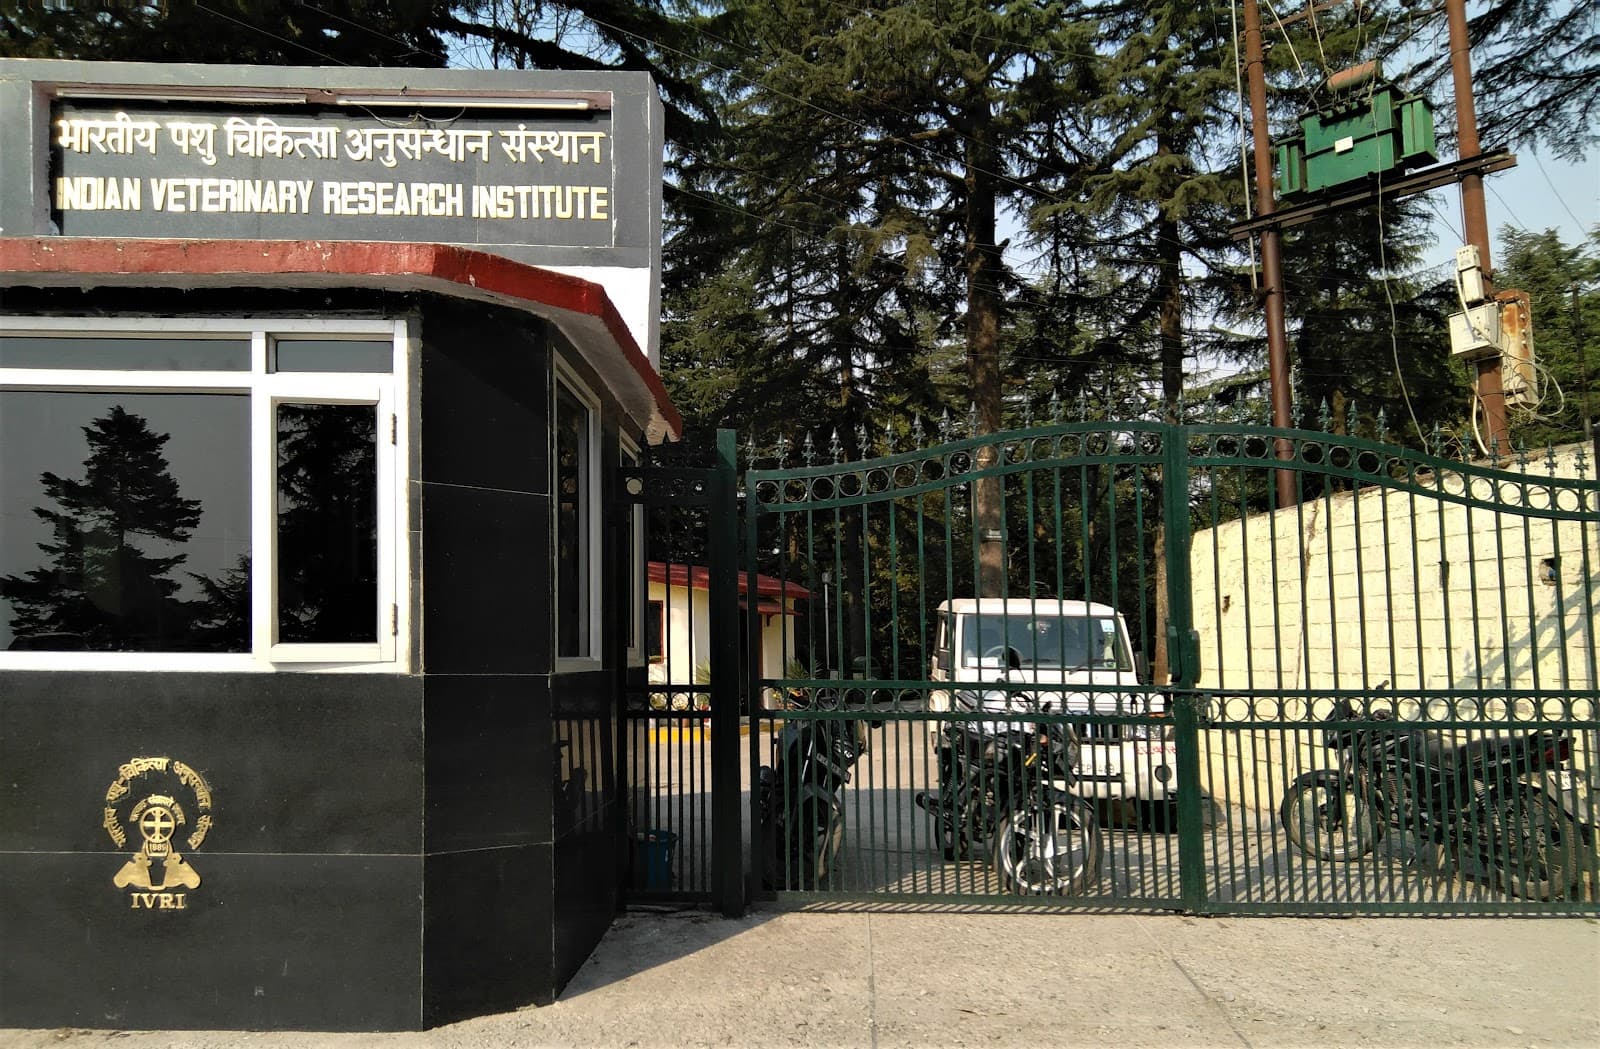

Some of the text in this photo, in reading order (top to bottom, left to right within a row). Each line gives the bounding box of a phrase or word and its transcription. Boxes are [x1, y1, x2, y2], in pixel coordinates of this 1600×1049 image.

[58, 112, 606, 167] भारतीय पशु चिकित्सा अनुसन्धान संस्थान
[56, 176, 609, 220] INDIAN VETERINARY RESEARCH INSTITUTE
[131, 892, 187, 910] IVRI
